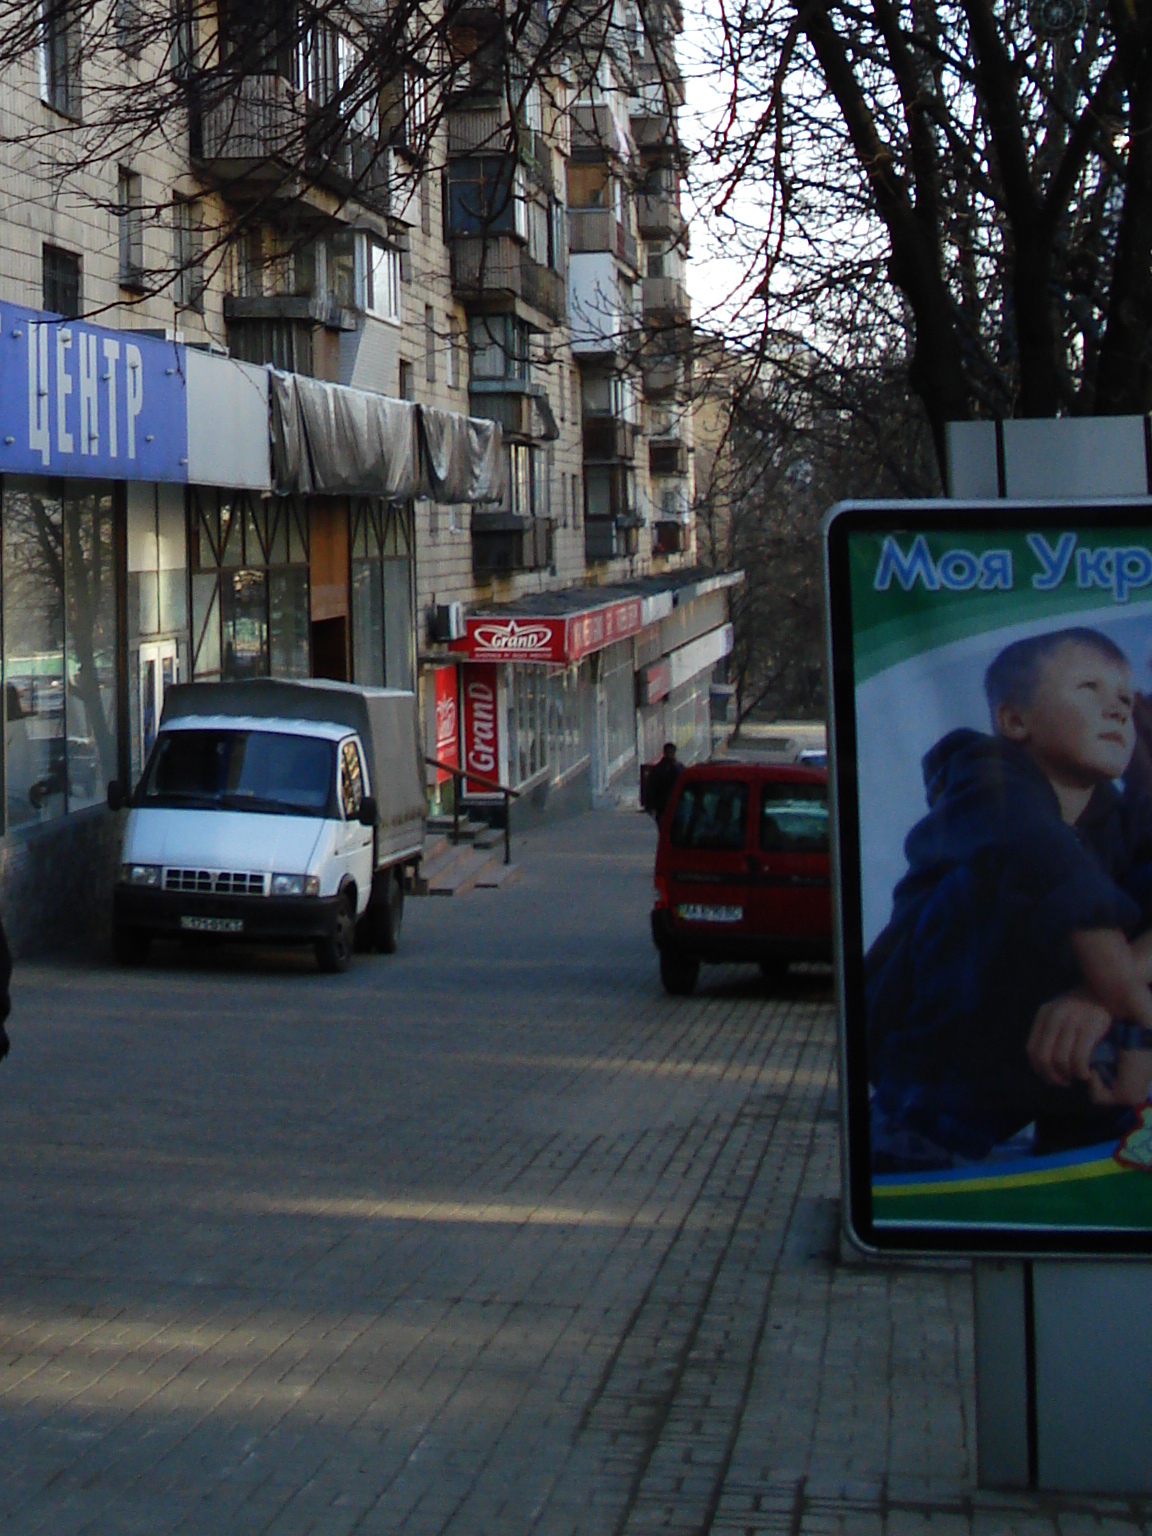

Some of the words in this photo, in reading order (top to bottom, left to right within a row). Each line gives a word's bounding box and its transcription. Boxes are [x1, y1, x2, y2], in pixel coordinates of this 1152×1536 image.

[28, 319, 143, 465] ЦЕНТР
[873, 533, 1014, 591] Моя
[1025, 531, 1152, 605] Укр
